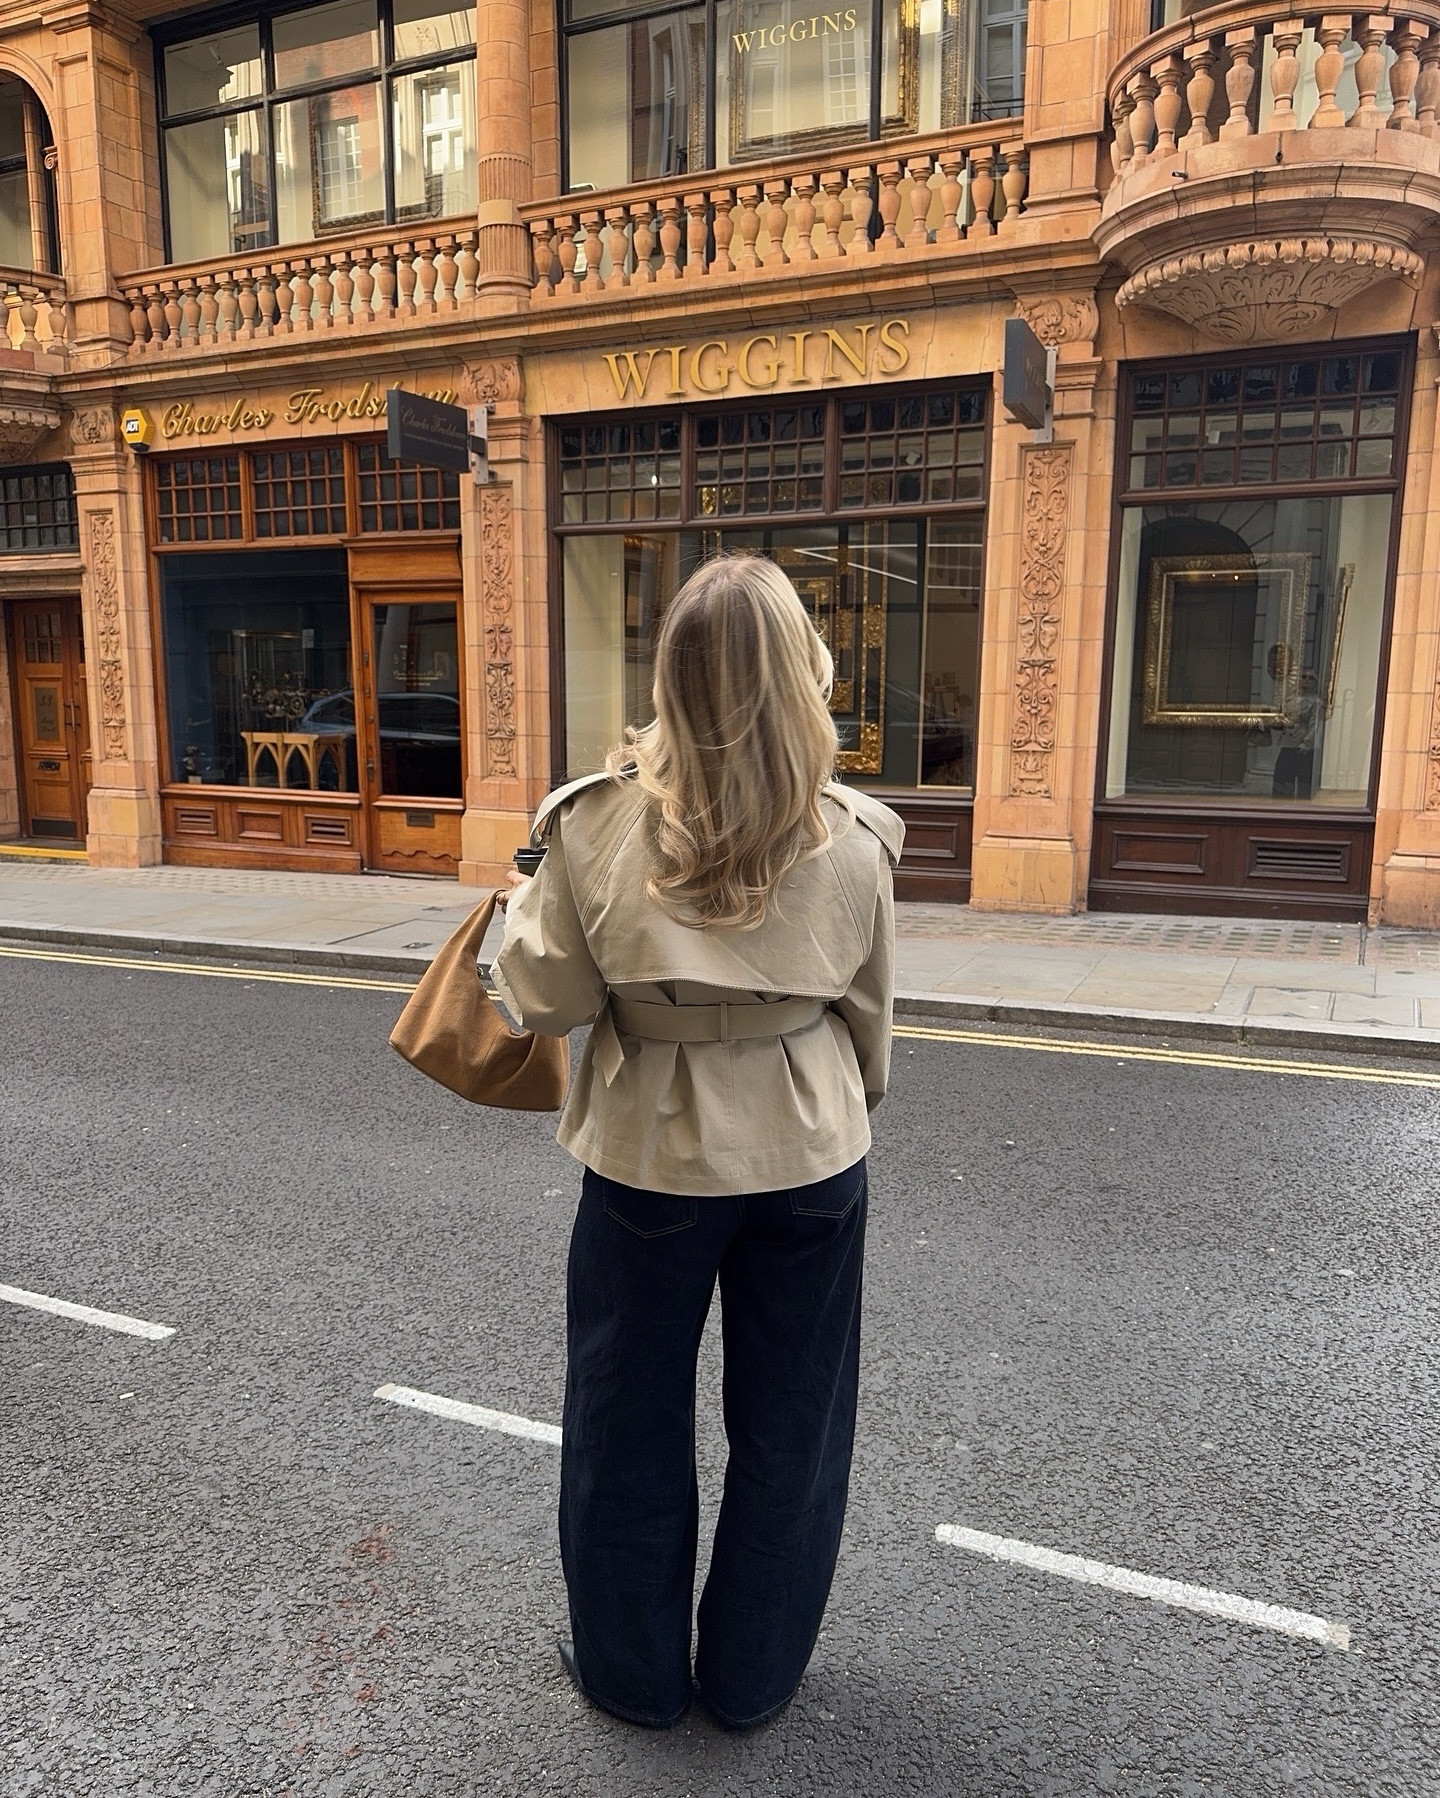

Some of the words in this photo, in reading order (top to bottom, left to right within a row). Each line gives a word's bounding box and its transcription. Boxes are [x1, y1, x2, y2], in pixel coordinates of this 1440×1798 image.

[732, 9, 857, 54] WIGGINS
[602, 319, 910, 400] WIGGINS
[126, 420, 140, 433] ADT
[161, 398, 271, 438] Charles
